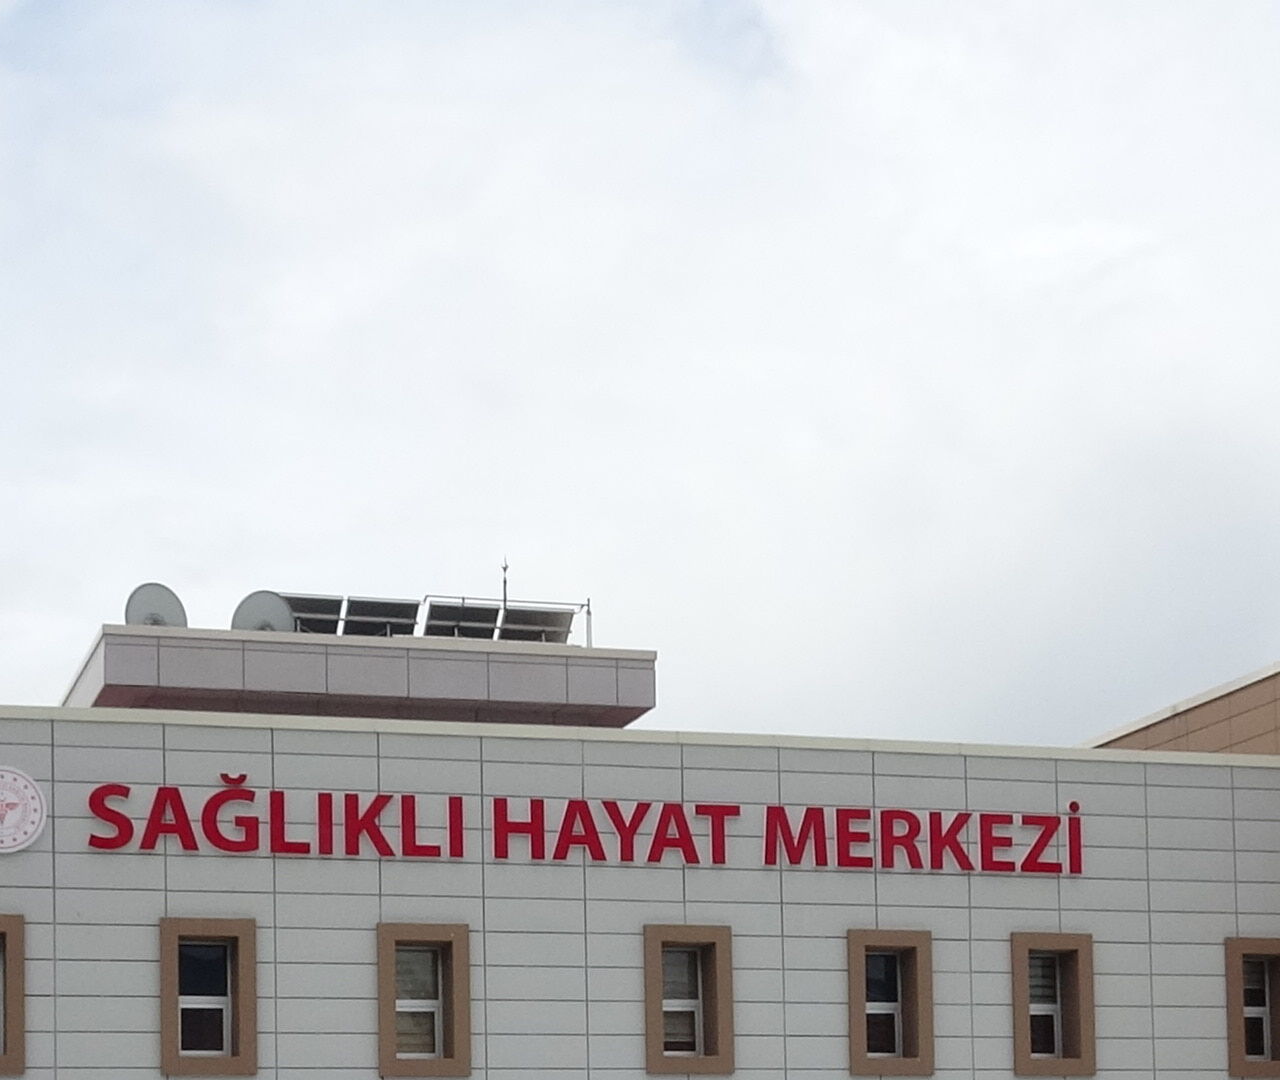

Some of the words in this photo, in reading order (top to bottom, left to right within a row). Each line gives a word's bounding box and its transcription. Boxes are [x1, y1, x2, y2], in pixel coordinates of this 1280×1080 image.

[88, 773, 465, 858] SAĞLIKLI
[492, 797, 741, 865] HAYAT
[763, 801, 1083, 875] MERKEZİ
